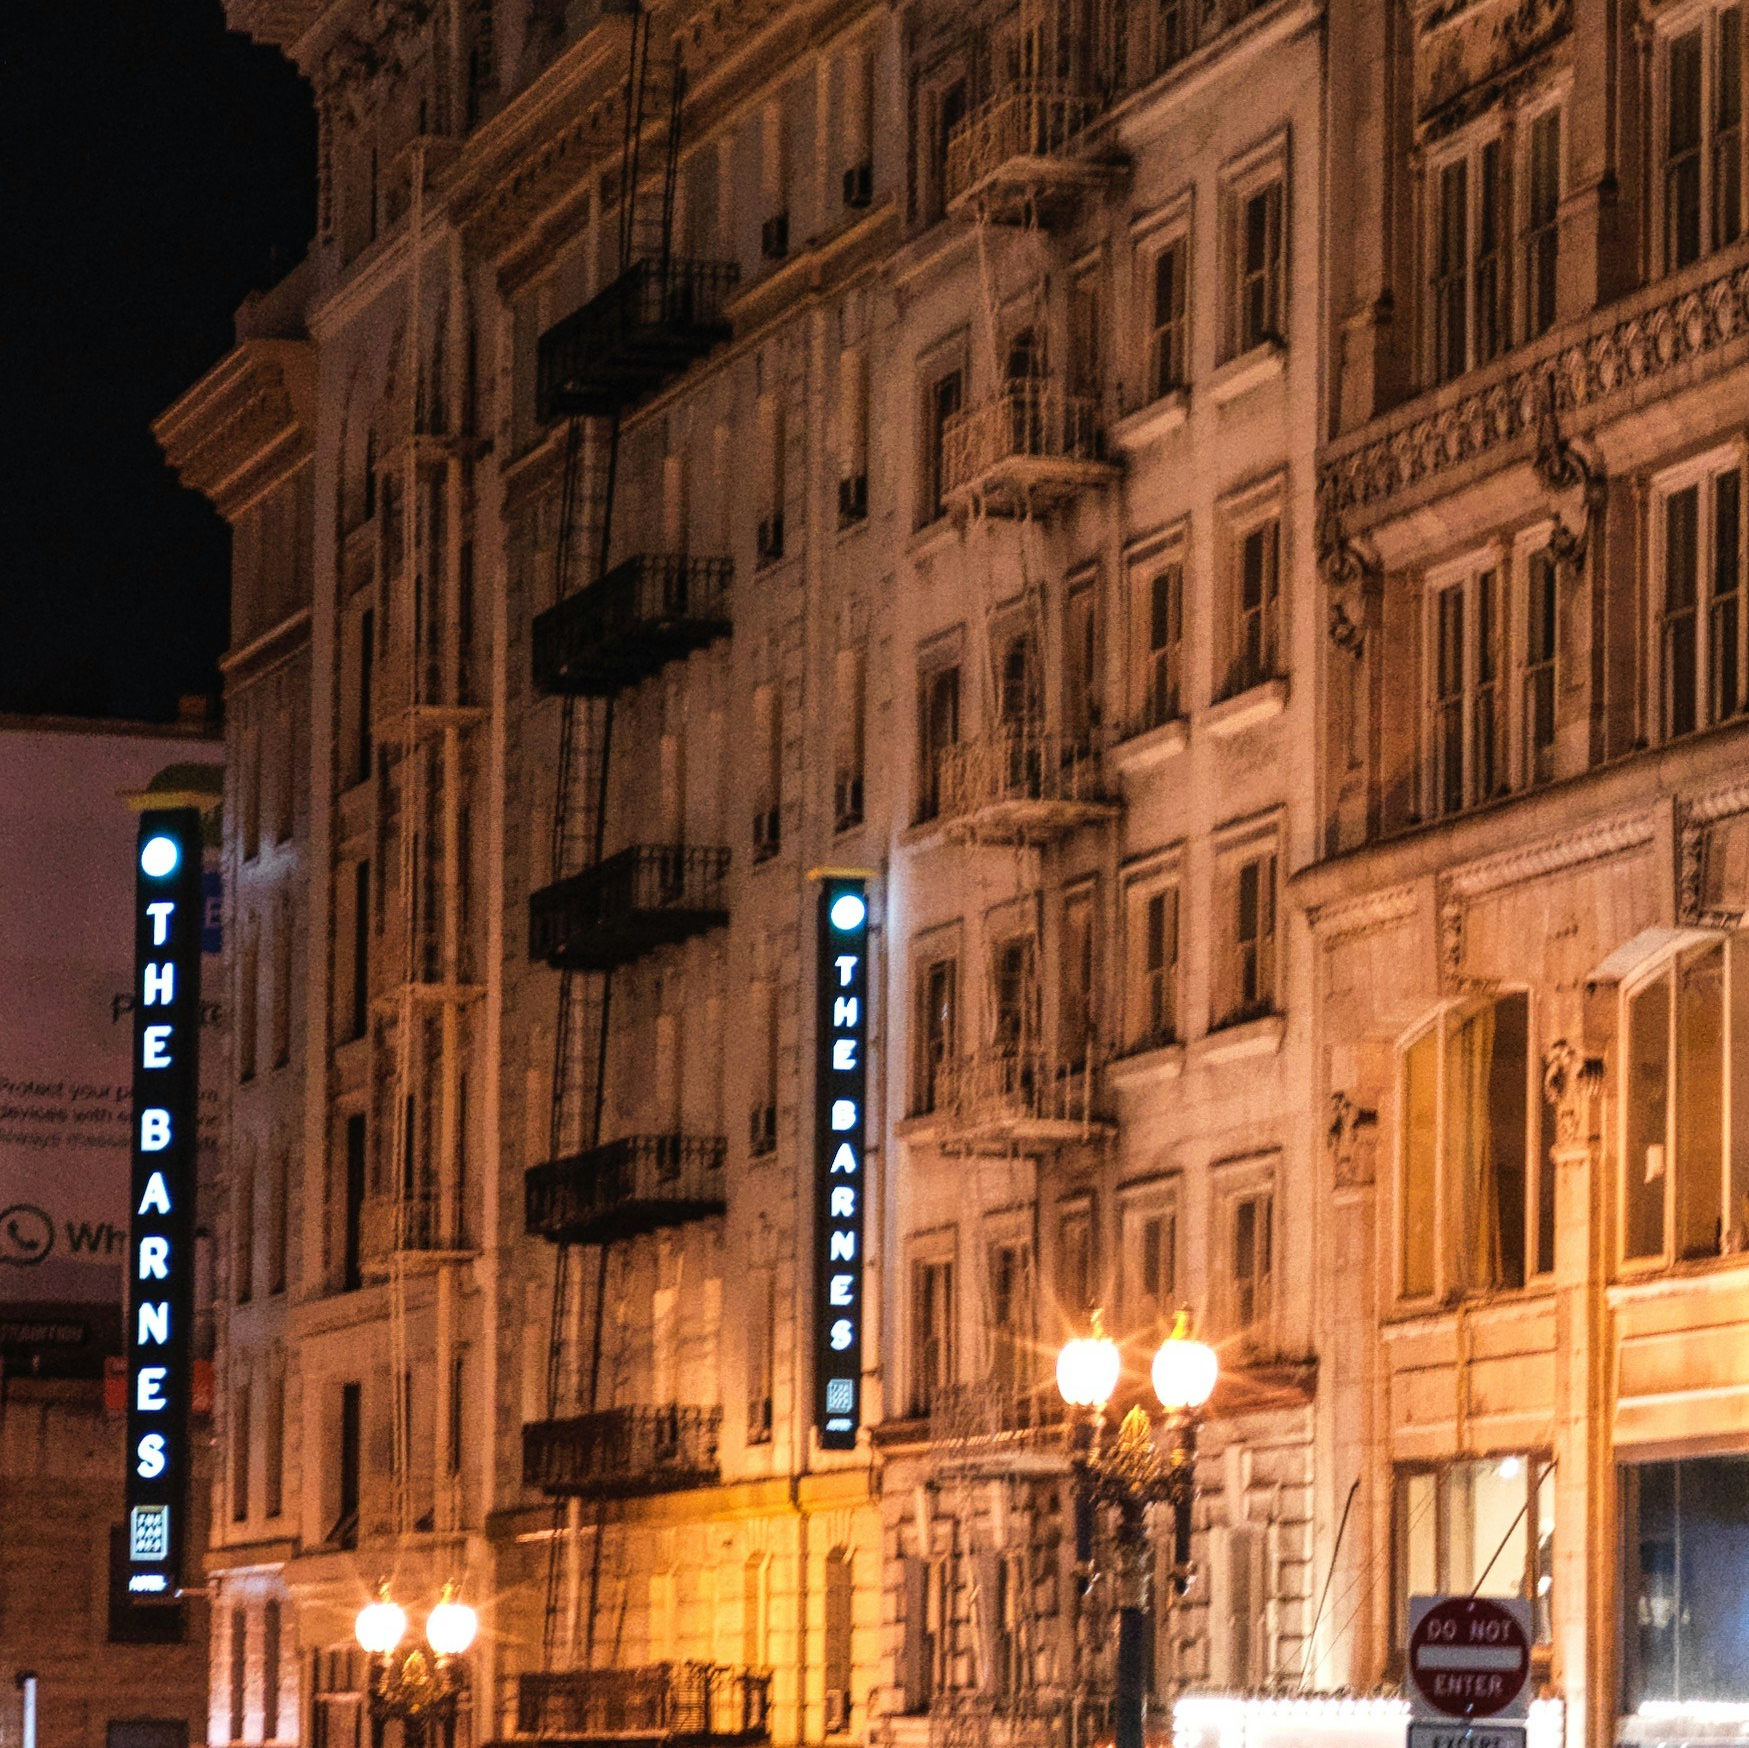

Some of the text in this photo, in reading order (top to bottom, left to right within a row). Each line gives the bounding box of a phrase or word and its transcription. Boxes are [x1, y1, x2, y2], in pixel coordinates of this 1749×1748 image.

[136, 902, 175, 1479] THE BARNES
[829, 955, 858, 1351] THE BARNES
[1427, 1618, 1512, 1642] DO NOT
[1434, 1674, 1502, 1697] ENTER
